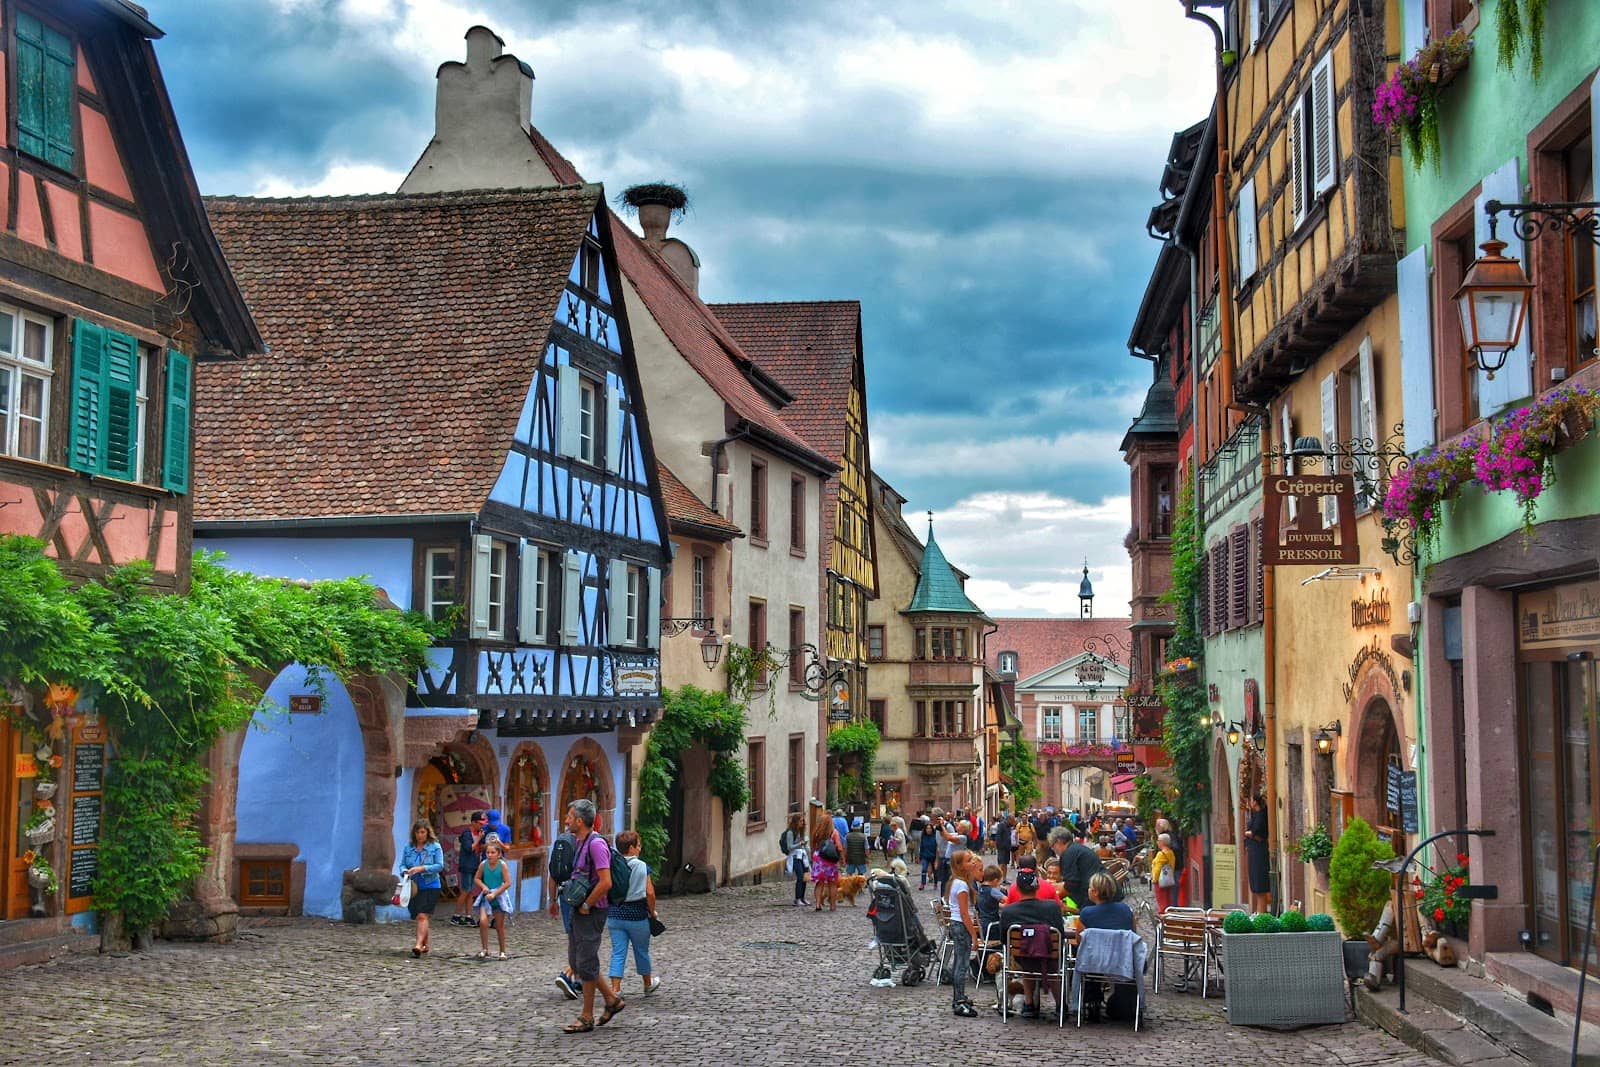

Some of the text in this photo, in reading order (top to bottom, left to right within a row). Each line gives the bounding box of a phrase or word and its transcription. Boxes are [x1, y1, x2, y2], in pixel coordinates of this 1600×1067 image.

[1275, 479, 1344, 497] Crêperie
[1288, 534, 1332, 542] DU VIEUX
[1279, 549, 1342, 560] PRESSOIR
